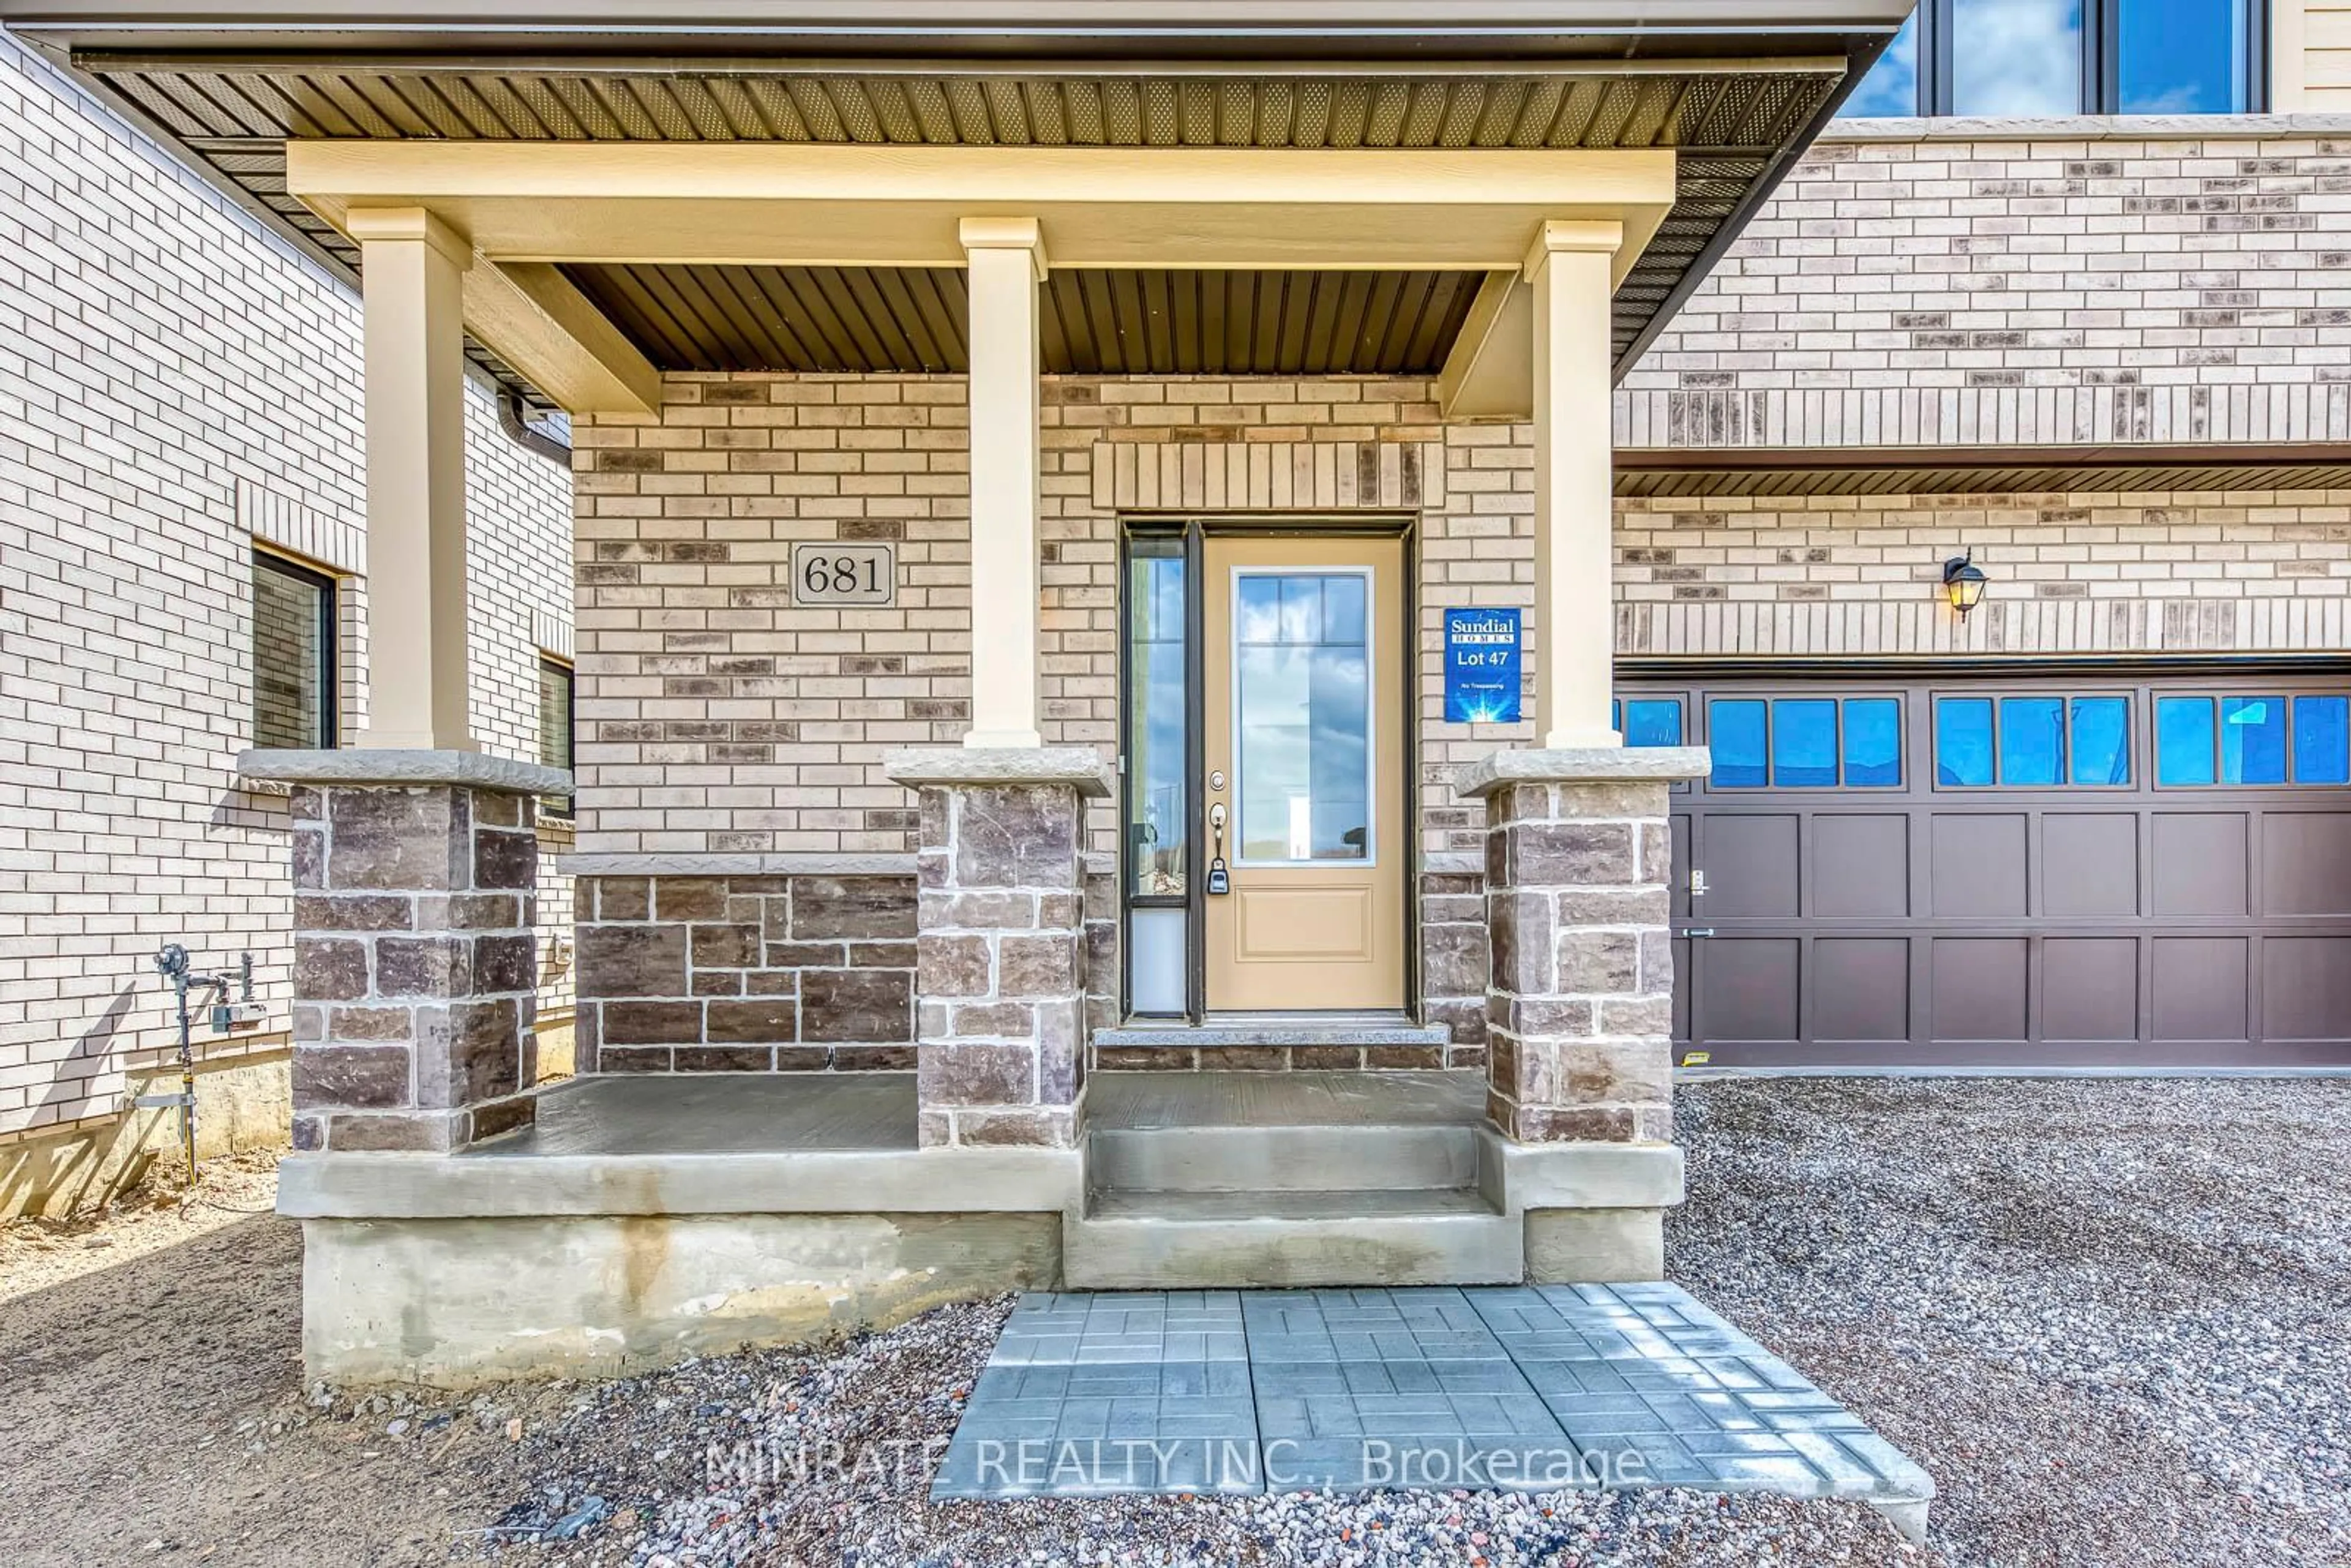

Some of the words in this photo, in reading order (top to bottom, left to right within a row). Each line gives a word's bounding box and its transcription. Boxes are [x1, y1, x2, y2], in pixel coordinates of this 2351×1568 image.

[805, 557, 882, 593] 681
[1452, 618, 1514, 632] Sundial
[1458, 651, 1485, 666] Lot
[1488, 651, 1509, 666] 47
